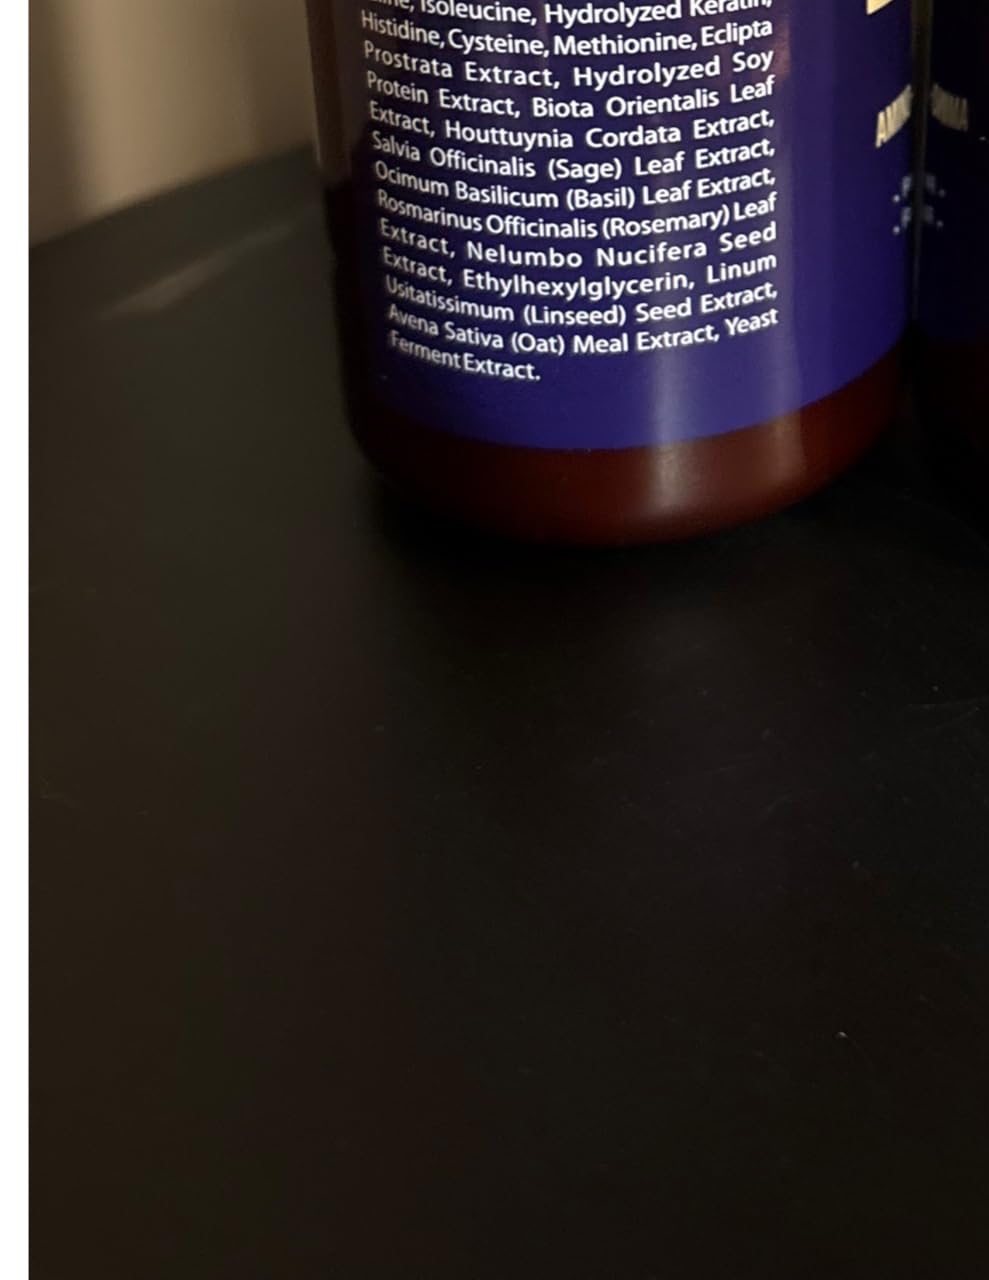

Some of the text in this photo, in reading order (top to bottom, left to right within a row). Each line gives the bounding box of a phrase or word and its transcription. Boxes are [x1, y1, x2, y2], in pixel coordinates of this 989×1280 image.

[701, 20, 773, 46] Eclipta
[465, 50, 774, 92] Extract, Hydrolyzed Soy
[439, 74, 776, 118] Extract, Biota Orientalis Leaf
[445, 119, 681, 152] Houttuynia Cordata
[430, 147, 686, 184] Officinalis (Sage) Leaf
[455, 179, 692, 211] Basilicum (Basil) Leaf
[486, 204, 730, 240] Officinalis (Rosemary)
[467, 221, 776, 268] Nelumbo Nucifera Seed
[463, 255, 777, 302] Ethylhexylglycerin, Linum
[523, 297, 692, 326] (Linseed) Seed
[444, 321, 720, 356] Sativa (Oat) Meal Extract,
